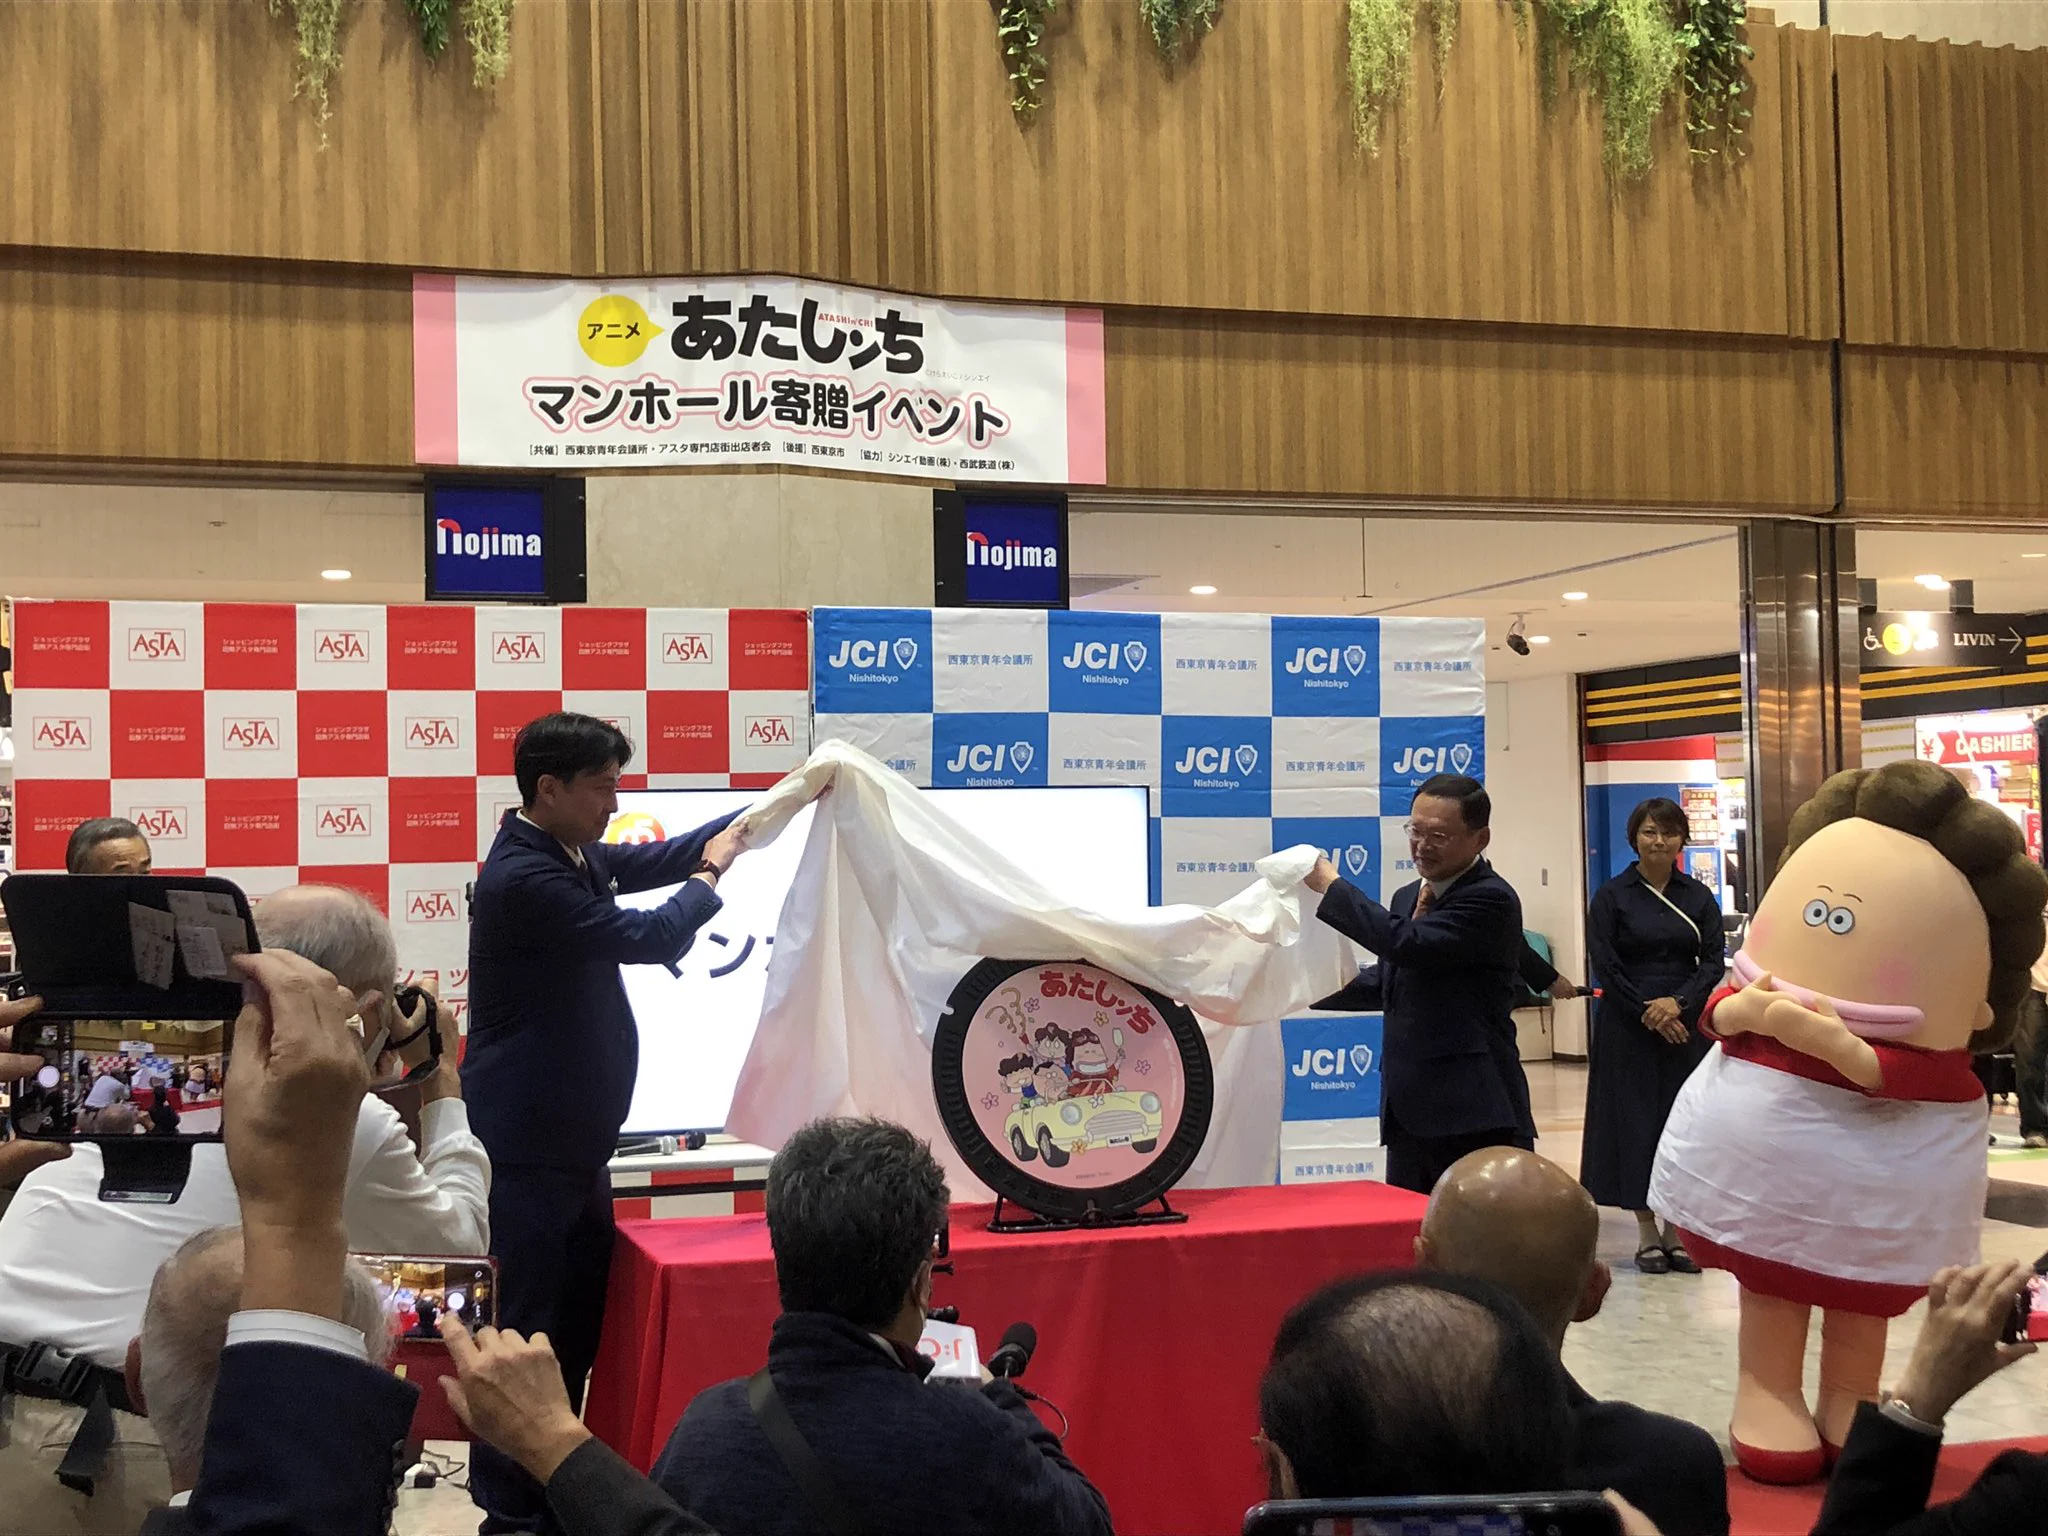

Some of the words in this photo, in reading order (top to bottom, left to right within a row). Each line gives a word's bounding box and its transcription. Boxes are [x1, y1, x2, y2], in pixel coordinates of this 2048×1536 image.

[587, 322, 642, 340] アニメ
[530, 379, 1003, 441] マンホール寄贈イベント
[437, 518, 541, 558] nojima
[967, 532, 1057, 572] nojima
[133, 630, 180, 657] ASTA
[319, 631, 364, 658] ASTA
[496, 634, 540, 659] ASTA
[666, 636, 708, 661] ASTA
[1953, 633, 1996, 646] LIVIN
[829, 639, 887, 669] JCI
[947, 653, 1033, 667] 西東京青年会議所
[1062, 641, 1119, 670] JCI
[1175, 658, 1258, 672] 西東京青年会議所
[1285, 647, 1340, 674] JCI
[1393, 660, 1472, 673] 西東京青年会議所
[848, 673, 899, 685] Nishitokyo
[1081, 675, 1129, 686] Nishitokyo
[1303, 678, 1349, 689] Nishitokyo
[38, 719, 86, 745] ASTA
[227, 719, 273, 746] ASTA
[409, 718, 455, 745] ASTA
[748, 717, 790, 743] ASTA
[1955, 733, 2033, 756] CASHIER
[946, 744, 1005, 772] JCI
[1062, 758, 1147, 771] 西東京青年会議所
[1175, 747, 1230, 773] JCI
[1285, 760, 1366, 773] 西東京青年会議所
[1393, 747, 1446, 774] JCI
[966, 777, 1014, 786] Nishitokyo
[1193, 779, 1239, 790] Nishitokyo
[136, 809, 182, 835] ASTA
[320, 807, 366, 832] ASTA
[410, 891, 456, 917] ASTA
[1292, 1048, 1345, 1077] JCI
[1310, 1080, 1356, 1092] Nishitokyo
[1295, 1161, 1375, 1177] 西東京青年会議所
